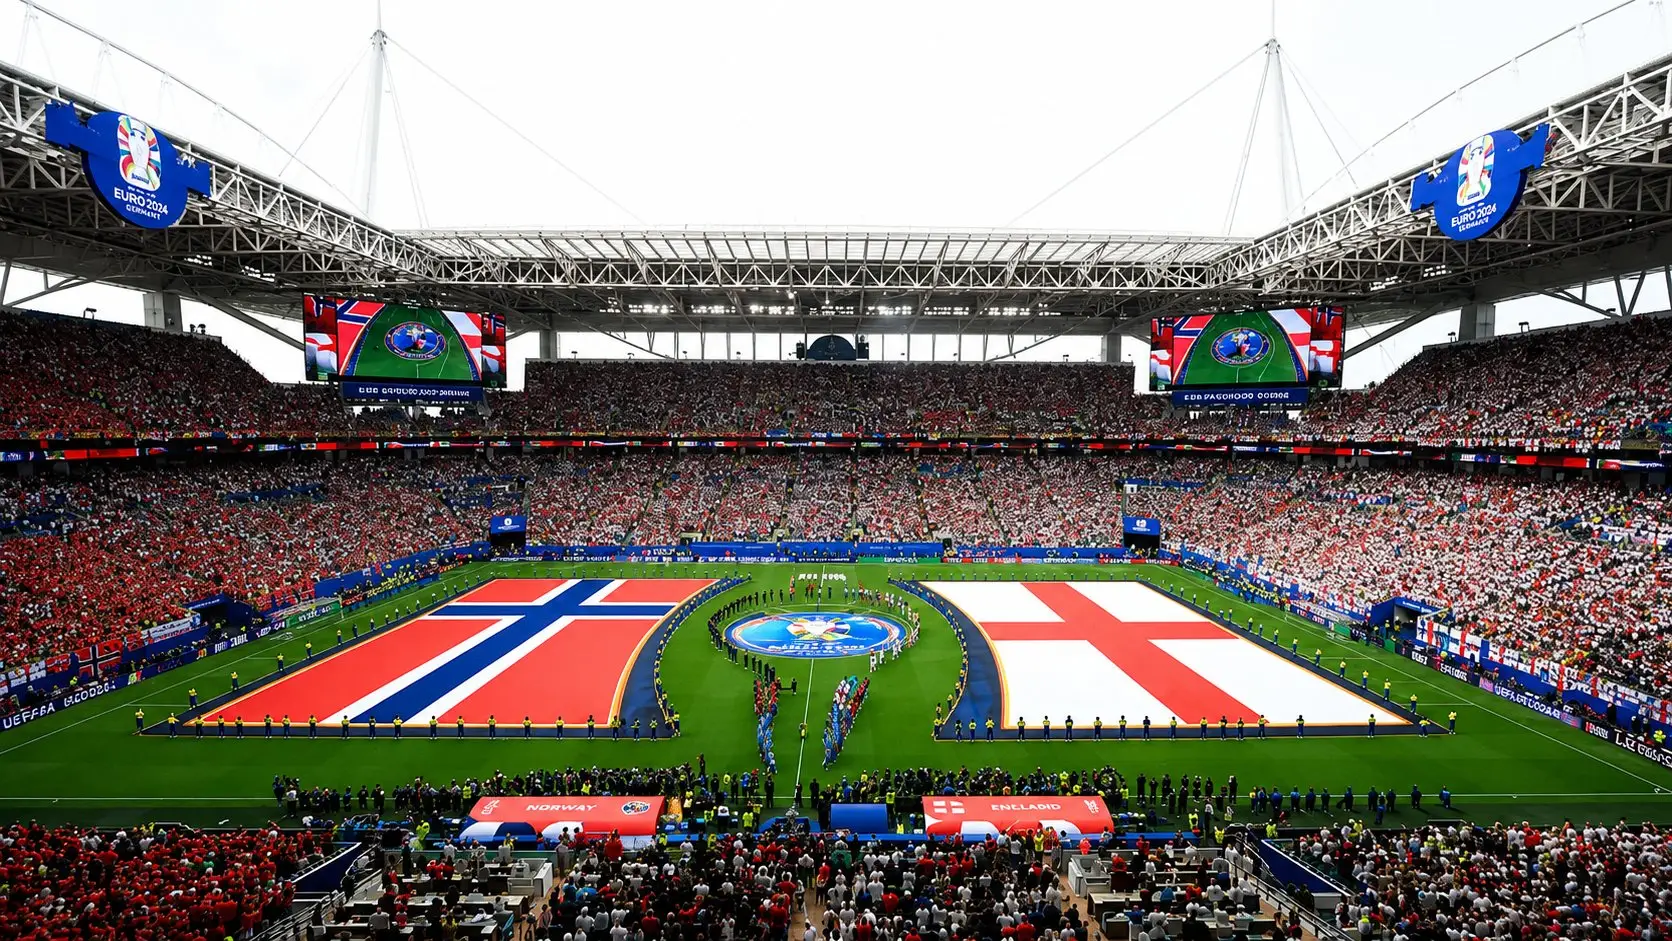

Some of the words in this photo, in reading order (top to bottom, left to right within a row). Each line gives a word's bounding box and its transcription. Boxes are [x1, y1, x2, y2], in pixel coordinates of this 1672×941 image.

[114, 187, 145, 207] EURO
[146, 199, 168, 215] 2024
[1451, 211, 1476, 227] EURO
[526, 804, 597, 812] NORWAY
